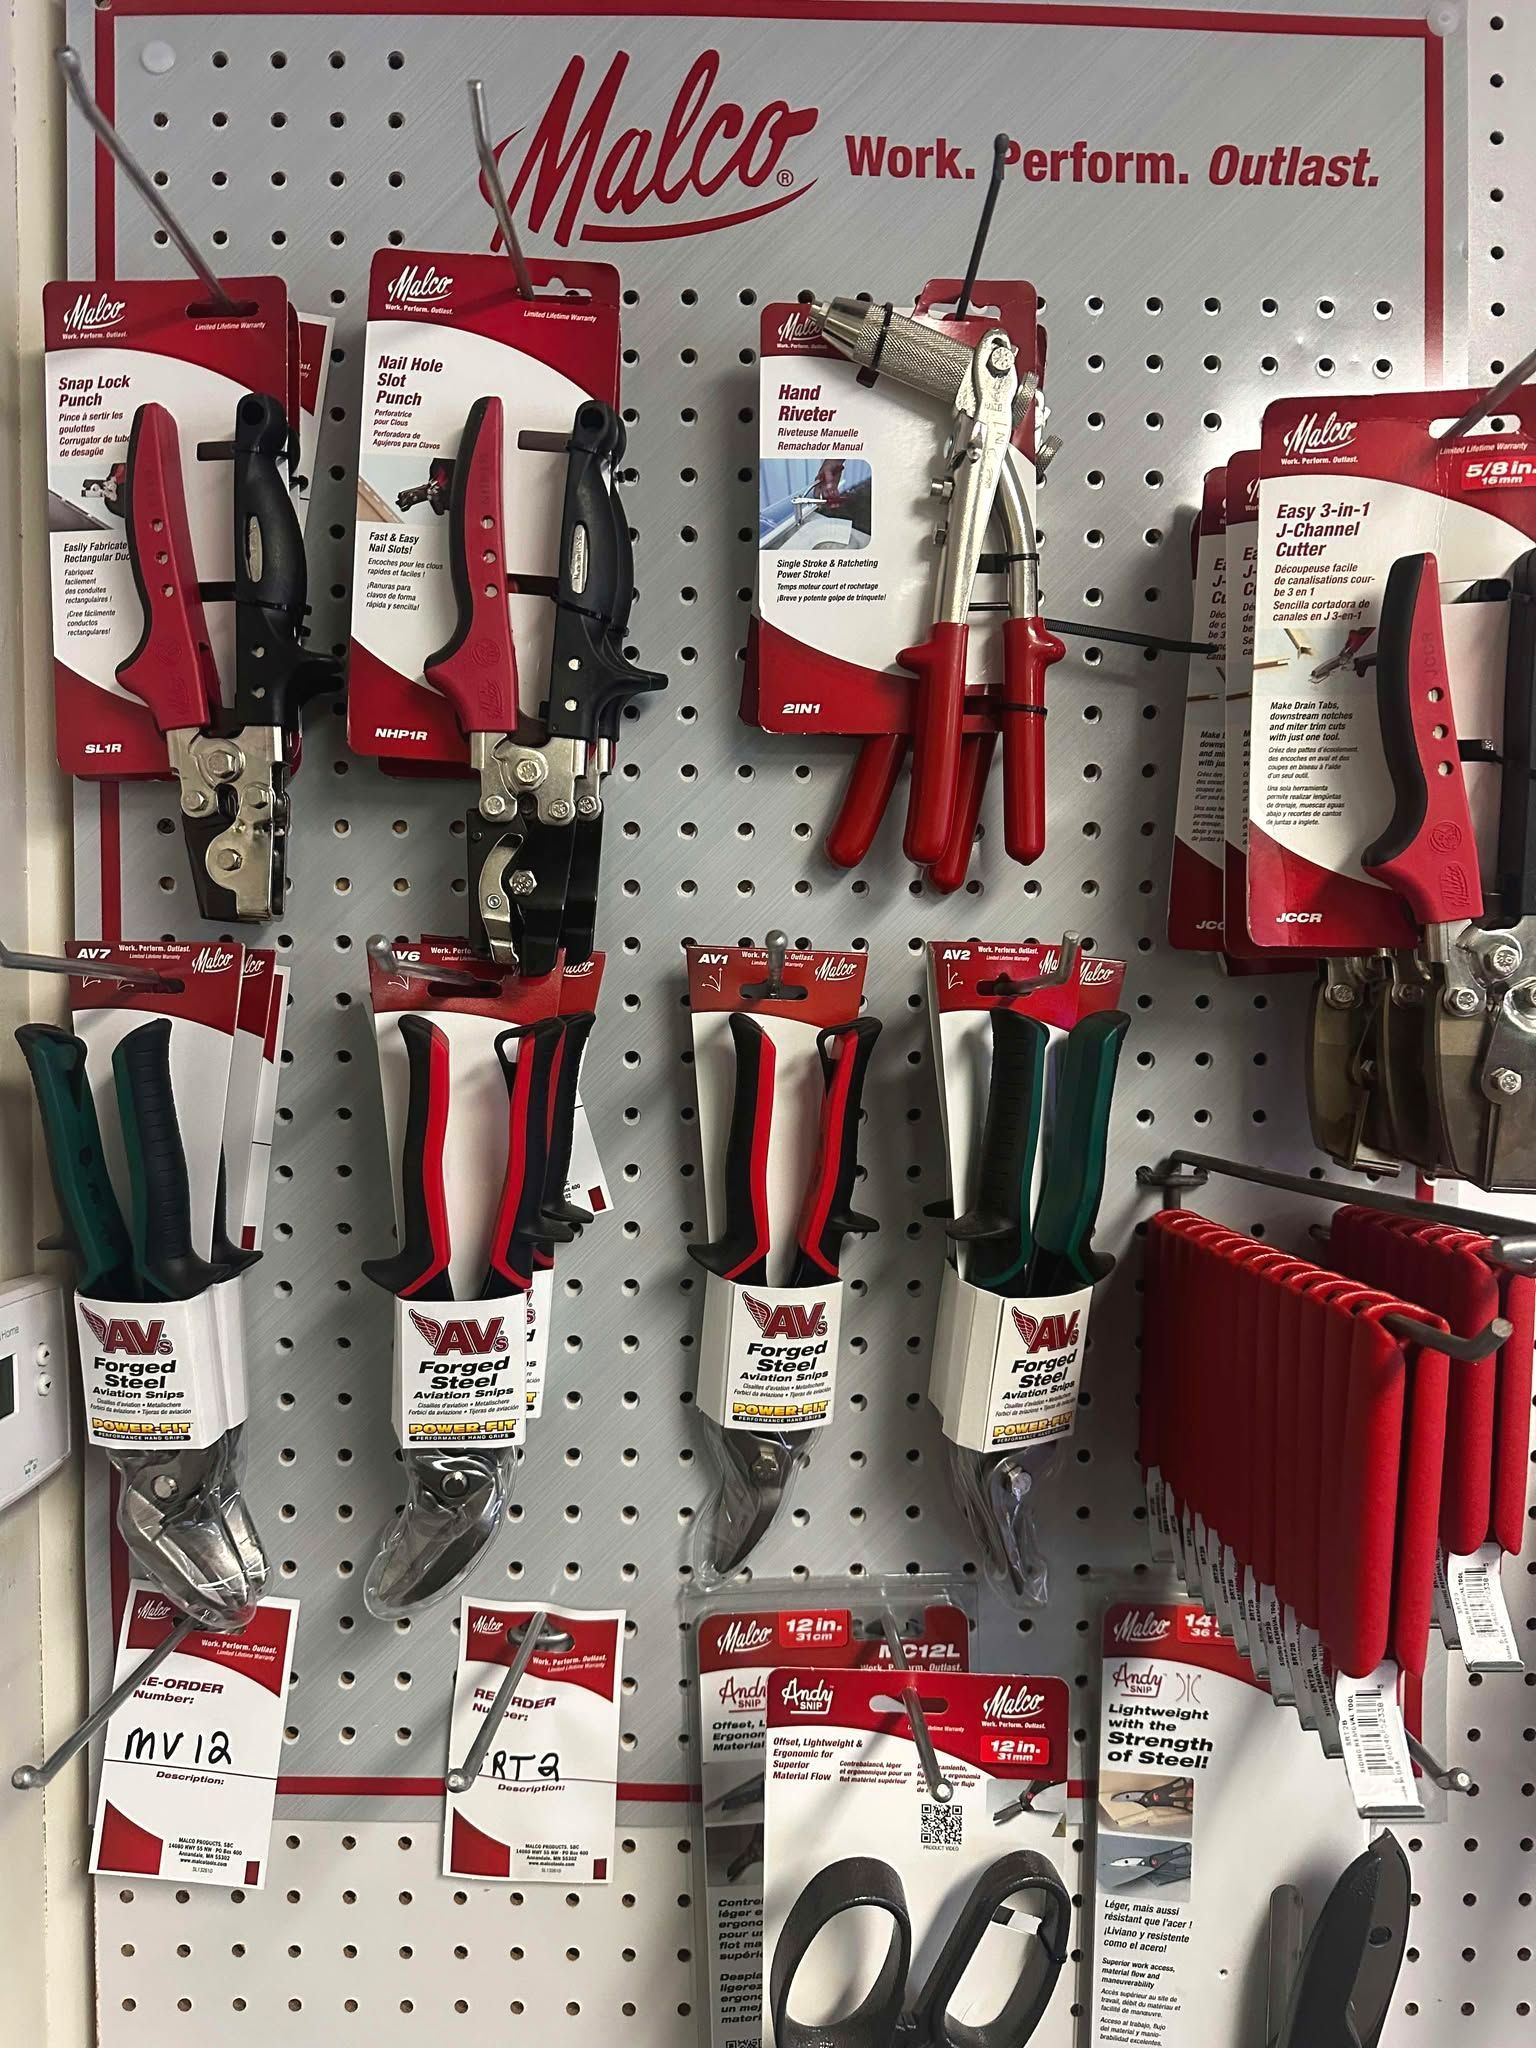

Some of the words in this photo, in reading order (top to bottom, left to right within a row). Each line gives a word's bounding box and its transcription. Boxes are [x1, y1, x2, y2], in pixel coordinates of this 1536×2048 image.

[845, 135, 975, 179] Work.
[1000, 139, 1188, 184] Perform.
[1208, 144, 1378, 186] Outlast.
[388, 266, 453, 302] Malco
[64, 293, 126, 331] Malco
[404, 305, 429, 313] Perform.
[524, 310, 545, 318] Limited
[546, 312, 569, 320] Lifetime
[570, 313, 597, 322] Warranty
[62, 332, 79, 340] Work.
[106, 331, 128, 339] Outlast.
[378, 356, 407, 370] Nail
[411, 358, 443, 372] Hole
[58, 377, 94, 392] Snap
[98, 374, 130, 389] Lock
[377, 373, 406, 387] Slot
[376, 391, 422, 405] Punch
[778, 384, 821, 400] Hand
[59, 393, 102, 407] Punch
[59, 413, 80, 422] Pince
[82, 413, 87, 421] à
[89, 412, 110, 420] sertir
[112, 411, 123, 420] les
[374, 409, 412, 418] Perforatrice
[778, 406, 836, 422] Riveter
[59, 424, 95, 434] goulottes
[374, 418, 388, 426] pour
[390, 418, 408, 426] Clous
[778, 428, 818, 437] Riveteuse
[820, 428, 858, 437] Manuelle
[1283, 412, 1358, 456] Malco
[778, 442, 831, 450] Remachador
[833, 442, 863, 451] Manual
[1281, 458, 1300, 466] Work.
[1302, 457, 1331, 465] Perform.
[1332, 456, 1358, 464] Outlast.
[1465, 461, 1508, 478] 5/8
[1510, 462, 1536, 474] in.
[1276, 504, 1315, 520] Easy
[1320, 502, 1370, 518] 3-in-1
[1276, 522, 1360, 538] J-Channel
[369, 532, 388, 541] Fast
[390, 534, 396, 542] &
[399, 534, 419, 545] Easy
[63, 543, 87, 552] Easily
[90, 541, 127, 551] Fabricate
[368, 544, 385, 553] Nail
[387, 544, 412, 554] Slots!
[1276, 542, 1326, 557] Cutter
[64, 553, 113, 563] Rectangular
[777, 560, 800, 569] Single
[802, 560, 827, 568] Stroke
[829, 560, 835, 568] &
[837, 559, 878, 568] Ratcheting
[777, 570, 801, 579] Power
[802, 570, 830, 578] Stroke!
[1273, 600, 1310, 610] Sencilla
[1312, 600, 1359, 609] cortadora
[1362, 599, 1370, 608] de
[782, 704, 821, 714] 2IN1
[1270, 702, 1292, 710] Make
[1294, 702, 1316, 710] Drain
[1318, 701, 1339, 710] Tabs,
[1270, 711, 1319, 721] downstream
[1321, 711, 1352, 720] notches
[375, 728, 428, 740] NHP1R
[85, 744, 122, 753] SL1R
[1276, 913, 1323, 923] JCCR
[77, 949, 111, 959] AV7
[192, 947, 233, 974] Malco
[698, 953, 728, 964] AV1
[943, 950, 970, 960] AV2
[815, 957, 857, 981] Malco
[747, 1340, 828, 1360] Forged
[94, 1357, 176, 1376] Forged
[419, 1356, 510, 1376] Forged
[757, 1357, 817, 1373] Steel
[1012, 1350, 1077, 1374] Forged
[105, 1375, 166, 1389] Steel
[431, 1373, 498, 1389] Steel
[740, 1372, 792, 1382] Aviation
[796, 1370, 828, 1381] Snips
[1019, 1367, 1068, 1388] Steel
[93, 1387, 141, 1399] Aviation
[145, 1391, 184, 1400] Snips
[413, 1391, 470, 1399] Aviation
[475, 1387, 514, 1398] Snips
[1002, 1385, 1047, 1400] Aviation
[1050, 1381, 1074, 1394] Snips
[137, 1599, 171, 1620] Malco
[472, 1616, 503, 1634] Malco
[786, 1619, 812, 1632] 12
[816, 1617, 842, 1631] in.
[1114, 1611, 1170, 1642] Malco
[717, 1620, 772, 1655] Malco
[201, 1639, 220, 1648] Work.
[222, 1641, 250, 1651] Perform.
[252, 1645, 277, 1654] Outlast.
[1113, 1662, 1165, 1694] Andy
[1130, 1685, 1152, 1694] SNIP
[133, 1690, 194, 1704] Number:
[983, 1685, 1044, 1719] Malco
[800, 1702, 822, 1711] SNIP
[1108, 1704, 1209, 1720] Lightweight
[1108, 1719, 1144, 1729] with
[1149, 1721, 1176, 1731] the
[773, 1738, 801, 1747] Offset,
[803, 1738, 854, 1749] Lightweight
[991, 1740, 1015, 1752] 12
[1017, 1740, 1040, 1753] in.
[1108, 1732, 1213, 1752] Strength
[773, 1750, 819, 1759] Ergonomic
[821, 1750, 833, 1758] for
[1107, 1749, 1133, 1762] of
[1138, 1752, 1209, 1769] Steel!
[773, 1760, 809, 1771] Superior
[156, 1771, 224, 1785] Description:
[773, 1771, 808, 1780] Material
[810, 1772, 831, 1780] Flow
[498, 1783, 565, 1793] Description:
[1105, 1900, 1130, 1913] Léger,
[1133, 1904, 1154, 1914] mais
[1156, 1906, 1179, 1916] aussi
[1104, 1939, 1128, 1950] como
[1130, 1941, 1138, 1949] el
[1140, 1941, 1167, 1953] acero!
